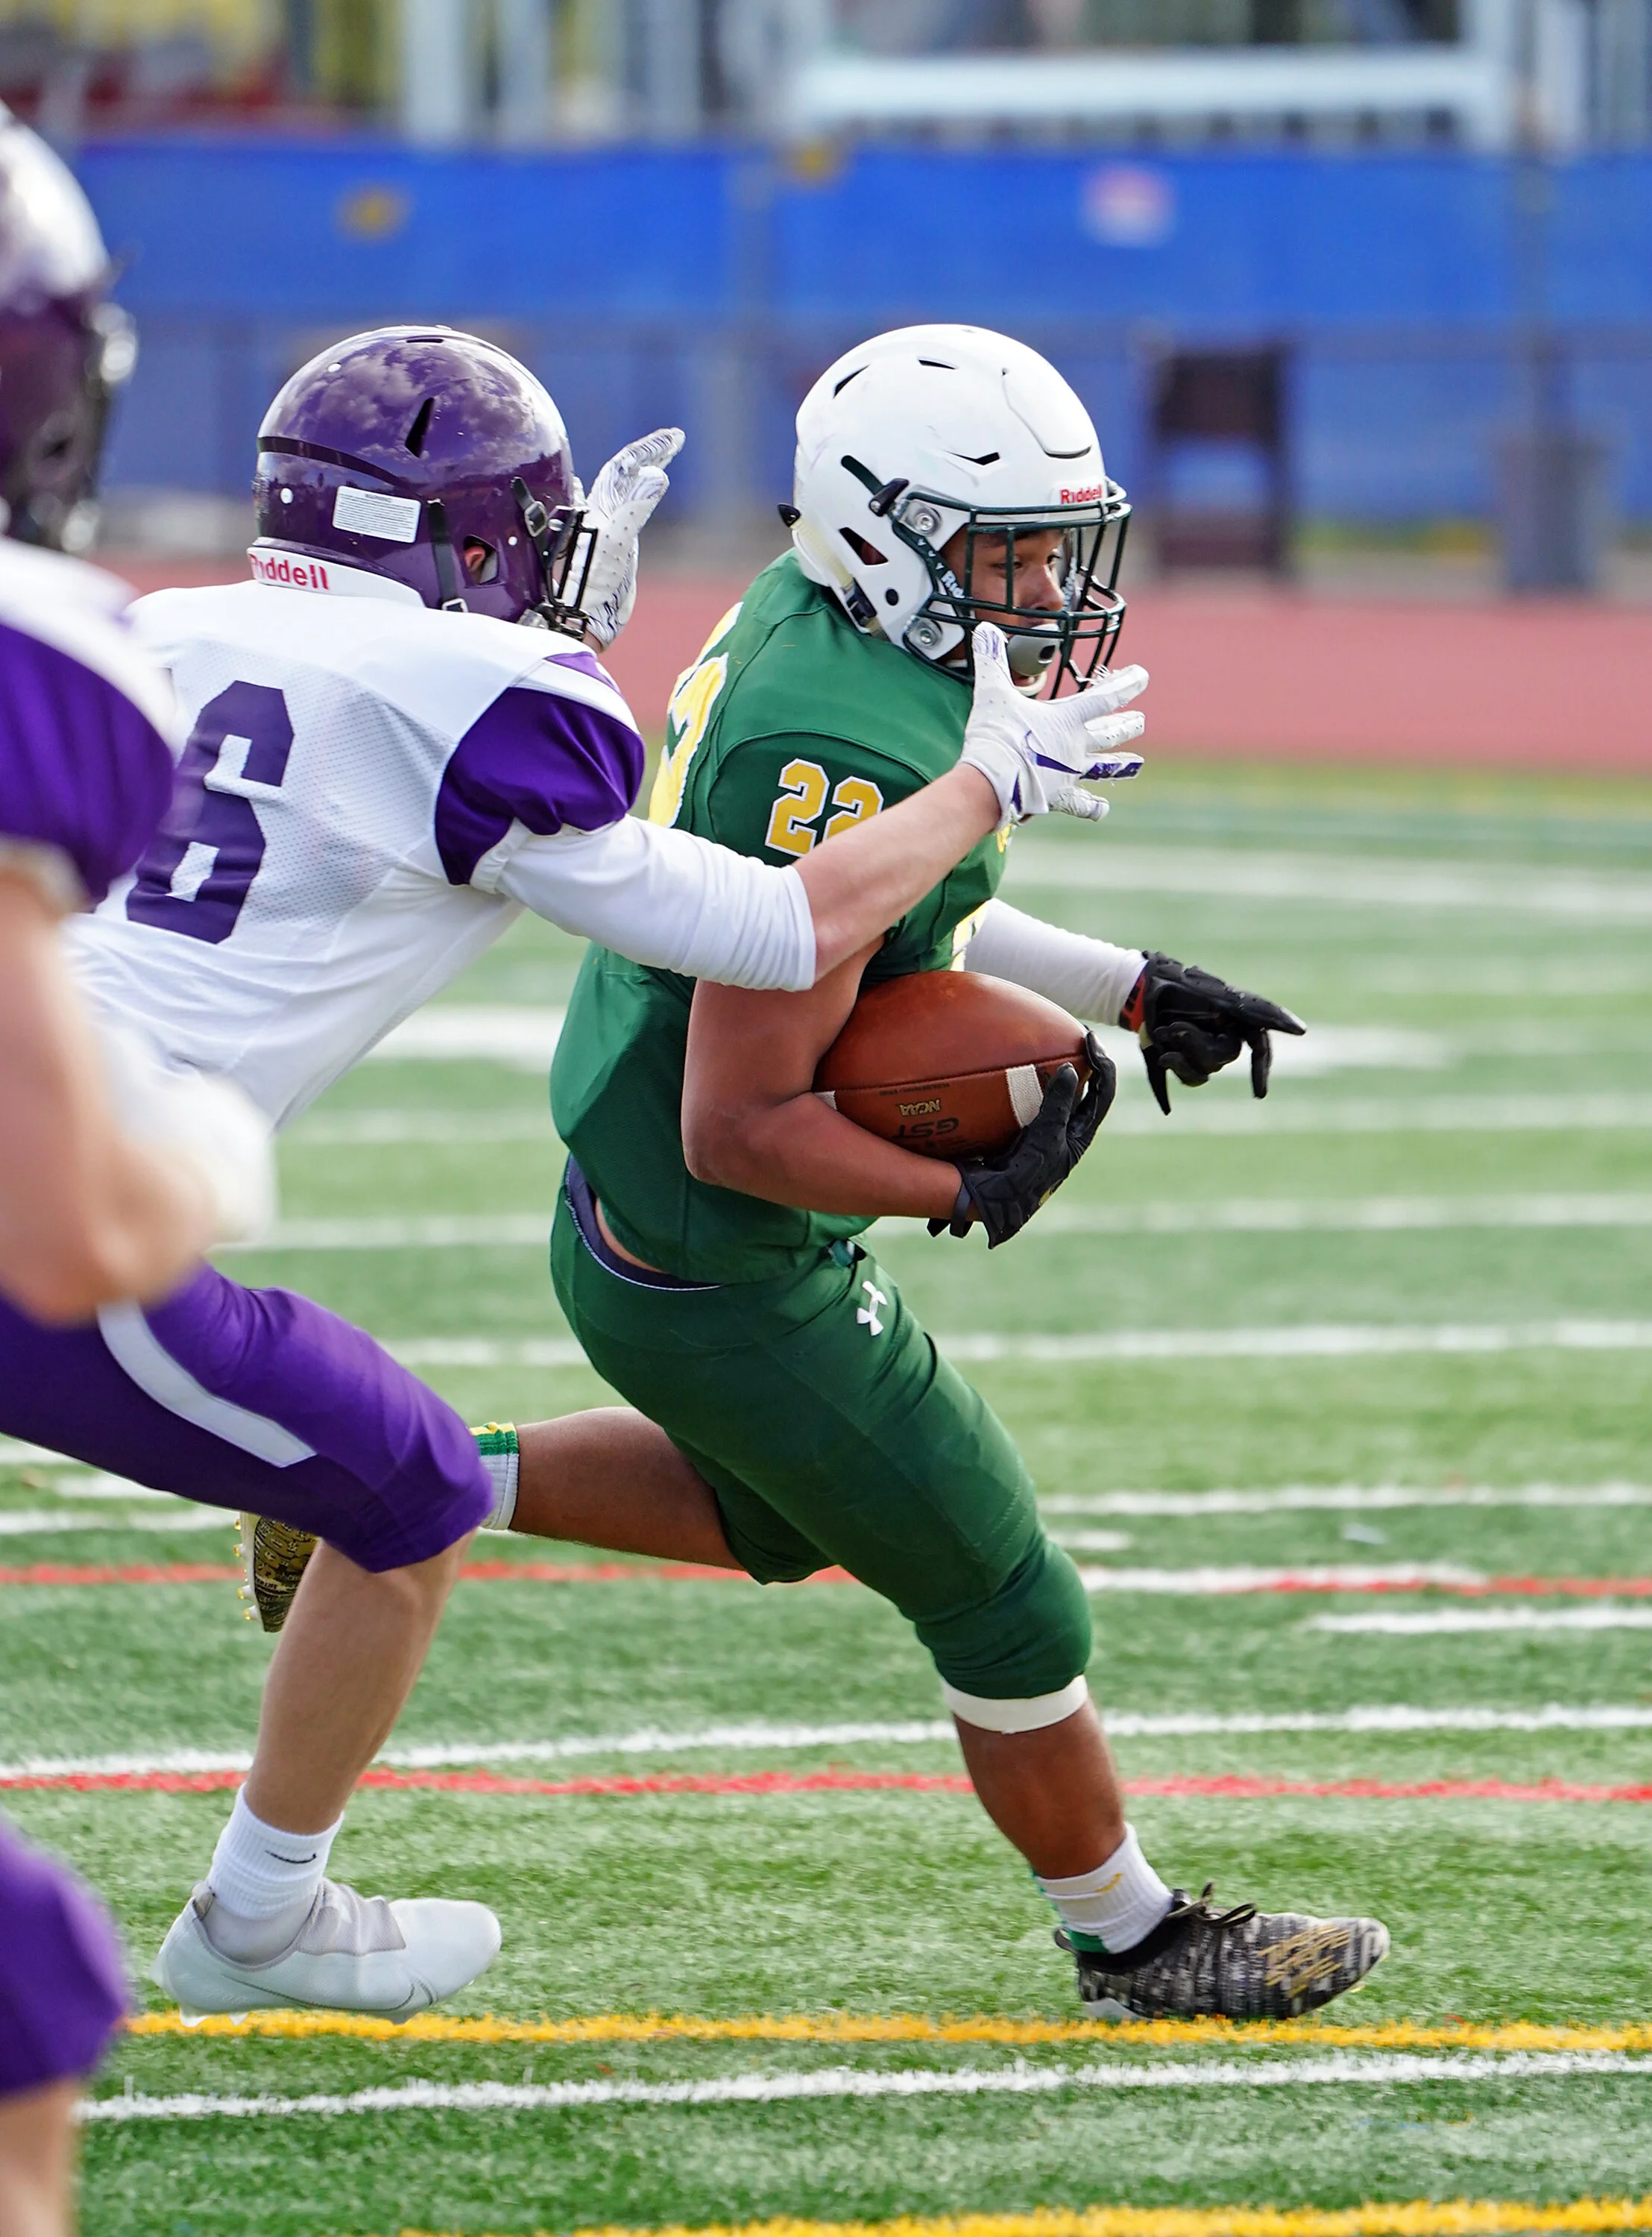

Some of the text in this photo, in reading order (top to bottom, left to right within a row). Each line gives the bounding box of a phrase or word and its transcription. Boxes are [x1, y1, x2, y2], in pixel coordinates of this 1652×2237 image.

[1060, 483, 1103, 505] Riddel
[125, 679, 295, 945] 6
[764, 758, 885, 858] 22
[898, 1098, 942, 1116] NCAA
[892, 1116, 959, 1139] GST
